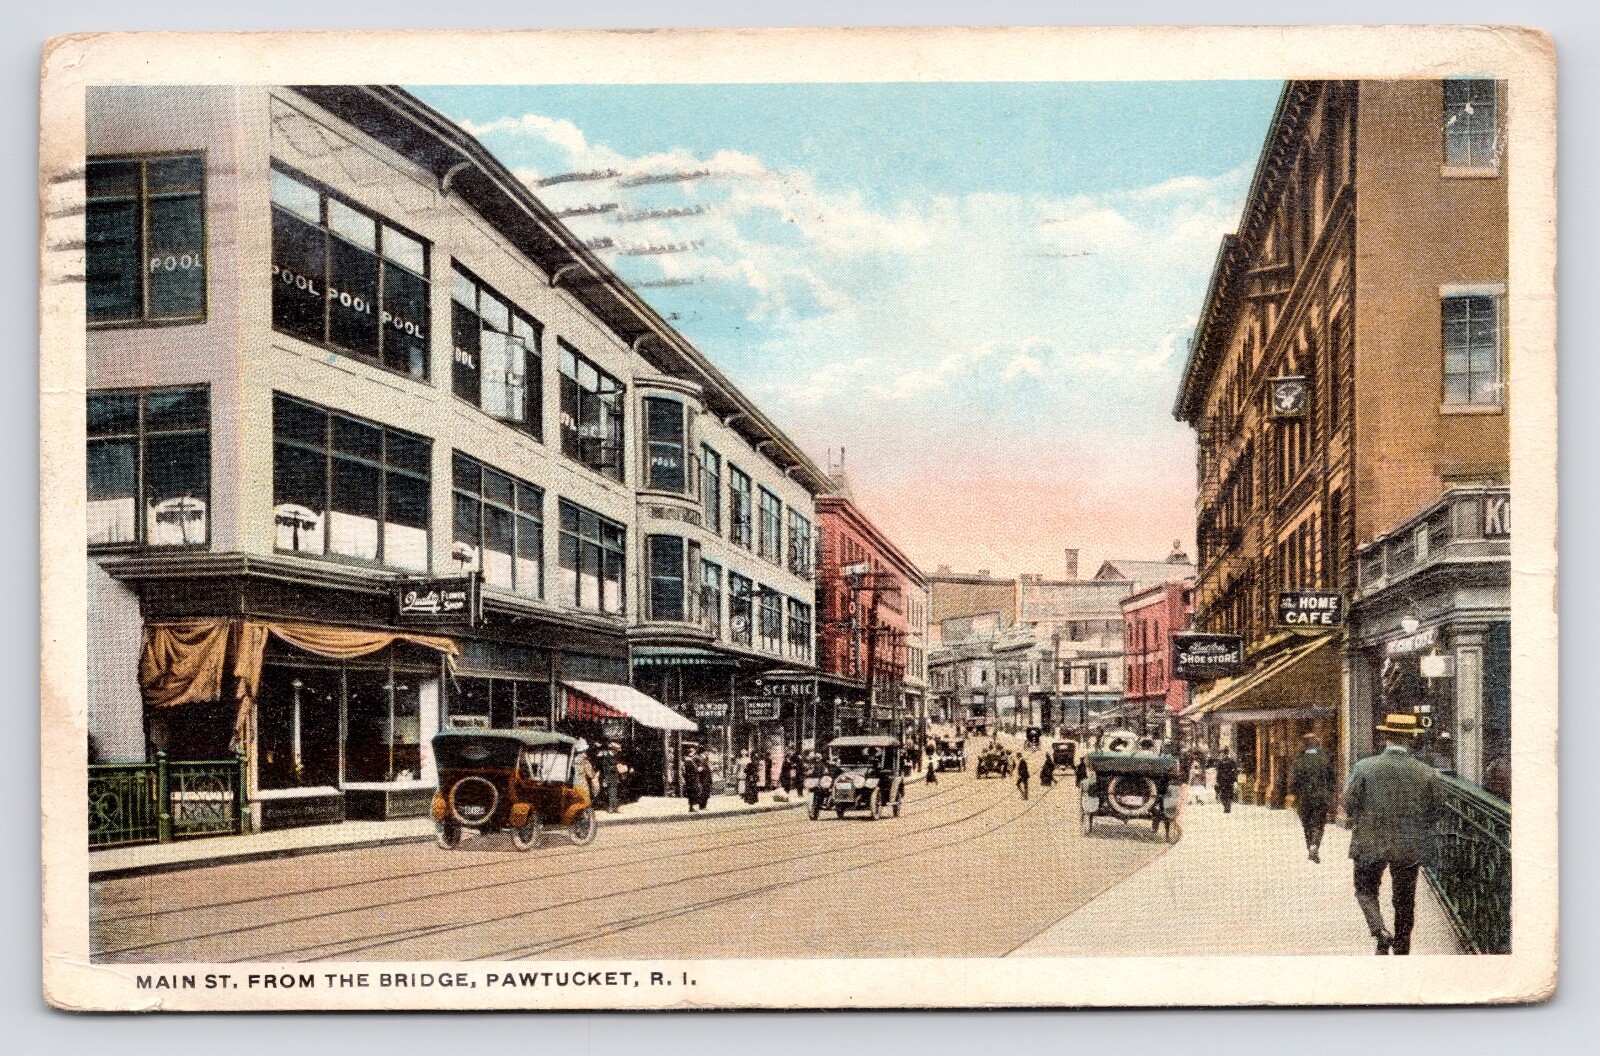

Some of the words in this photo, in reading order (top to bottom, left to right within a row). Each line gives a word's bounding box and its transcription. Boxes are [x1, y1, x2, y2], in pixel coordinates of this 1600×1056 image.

[151, 254, 202, 272] POOL
[381, 311, 424, 339] POOL
[1299, 597, 1338, 609] HOME
[1285, 611, 1333, 624] CAFE
[1180, 652, 1206, 665] SHOE
[1207, 651, 1239, 663] STORE
[763, 683, 812, 697] SCENIC
